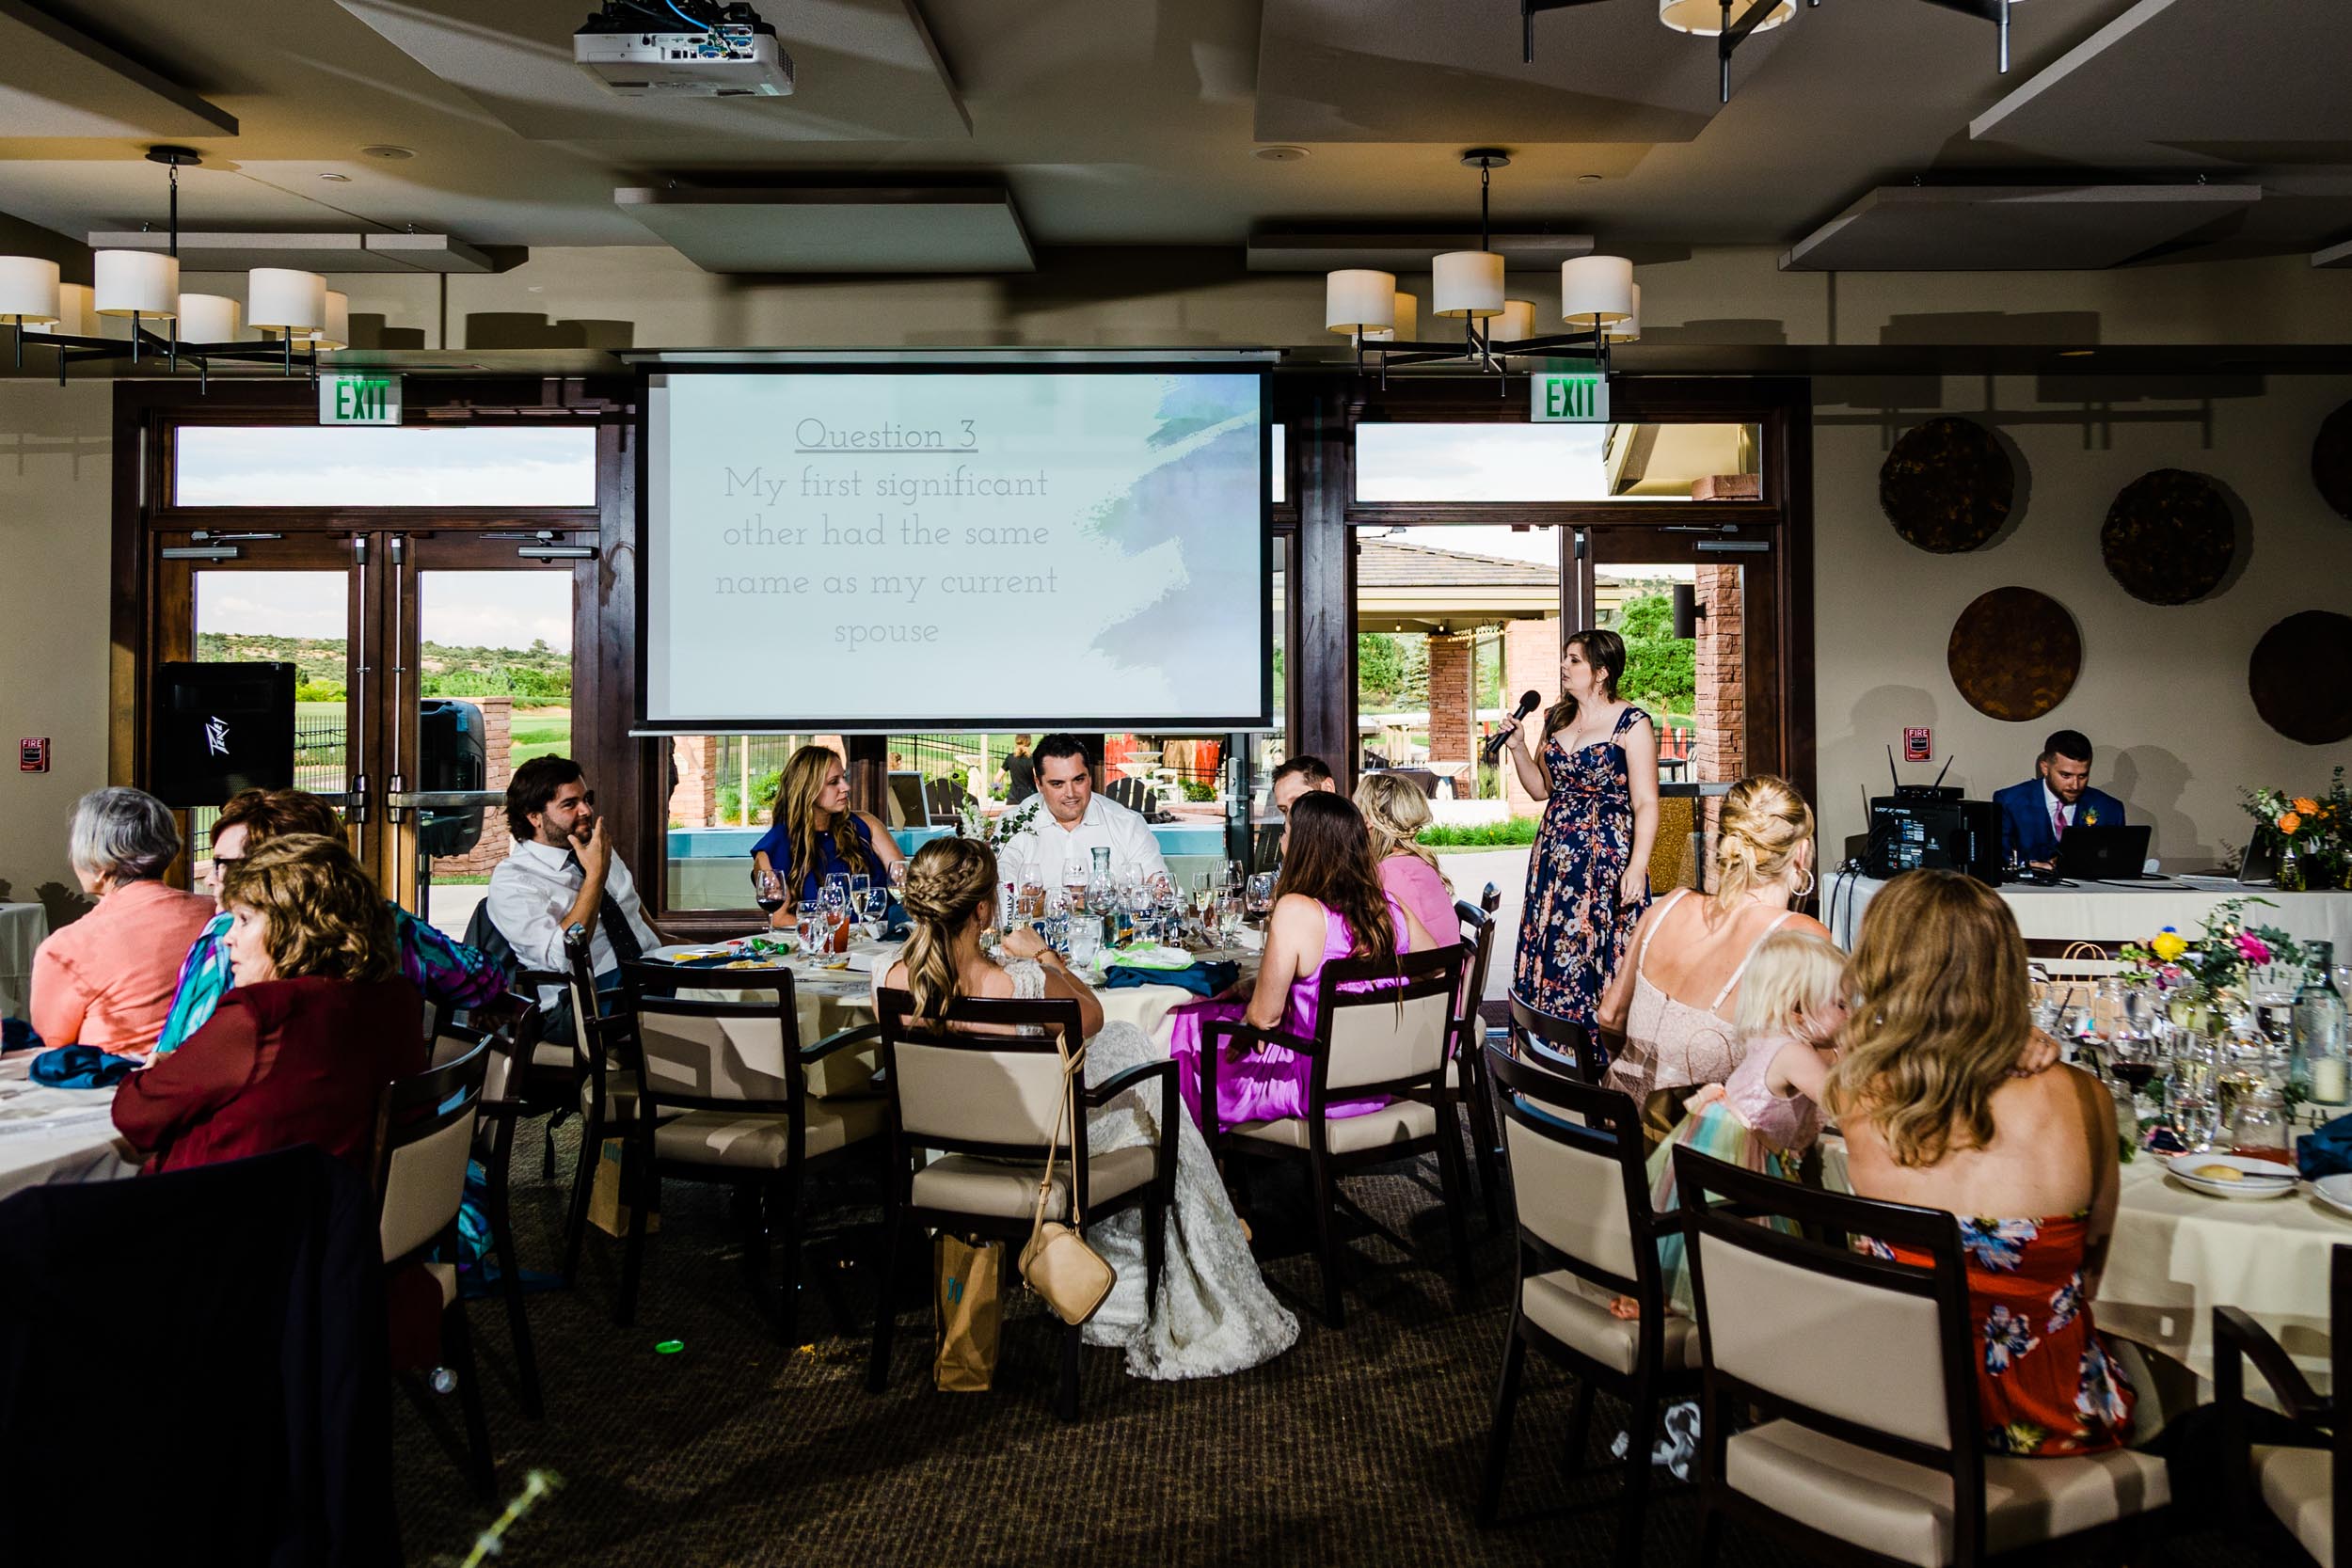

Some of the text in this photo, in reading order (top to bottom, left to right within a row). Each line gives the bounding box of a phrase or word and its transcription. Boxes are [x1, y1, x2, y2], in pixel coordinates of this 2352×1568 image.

[336, 380, 390, 420] EXIT
[1546, 378, 1598, 417] EXIT
[794, 418, 978, 449] Question 3
[723, 465, 1049, 507] My first significant
[723, 514, 1050, 546] other had the same
[715, 566, 1058, 604] name as my current
[834, 625, 940, 653] spouse
[23, 739, 42, 748] FIRE
